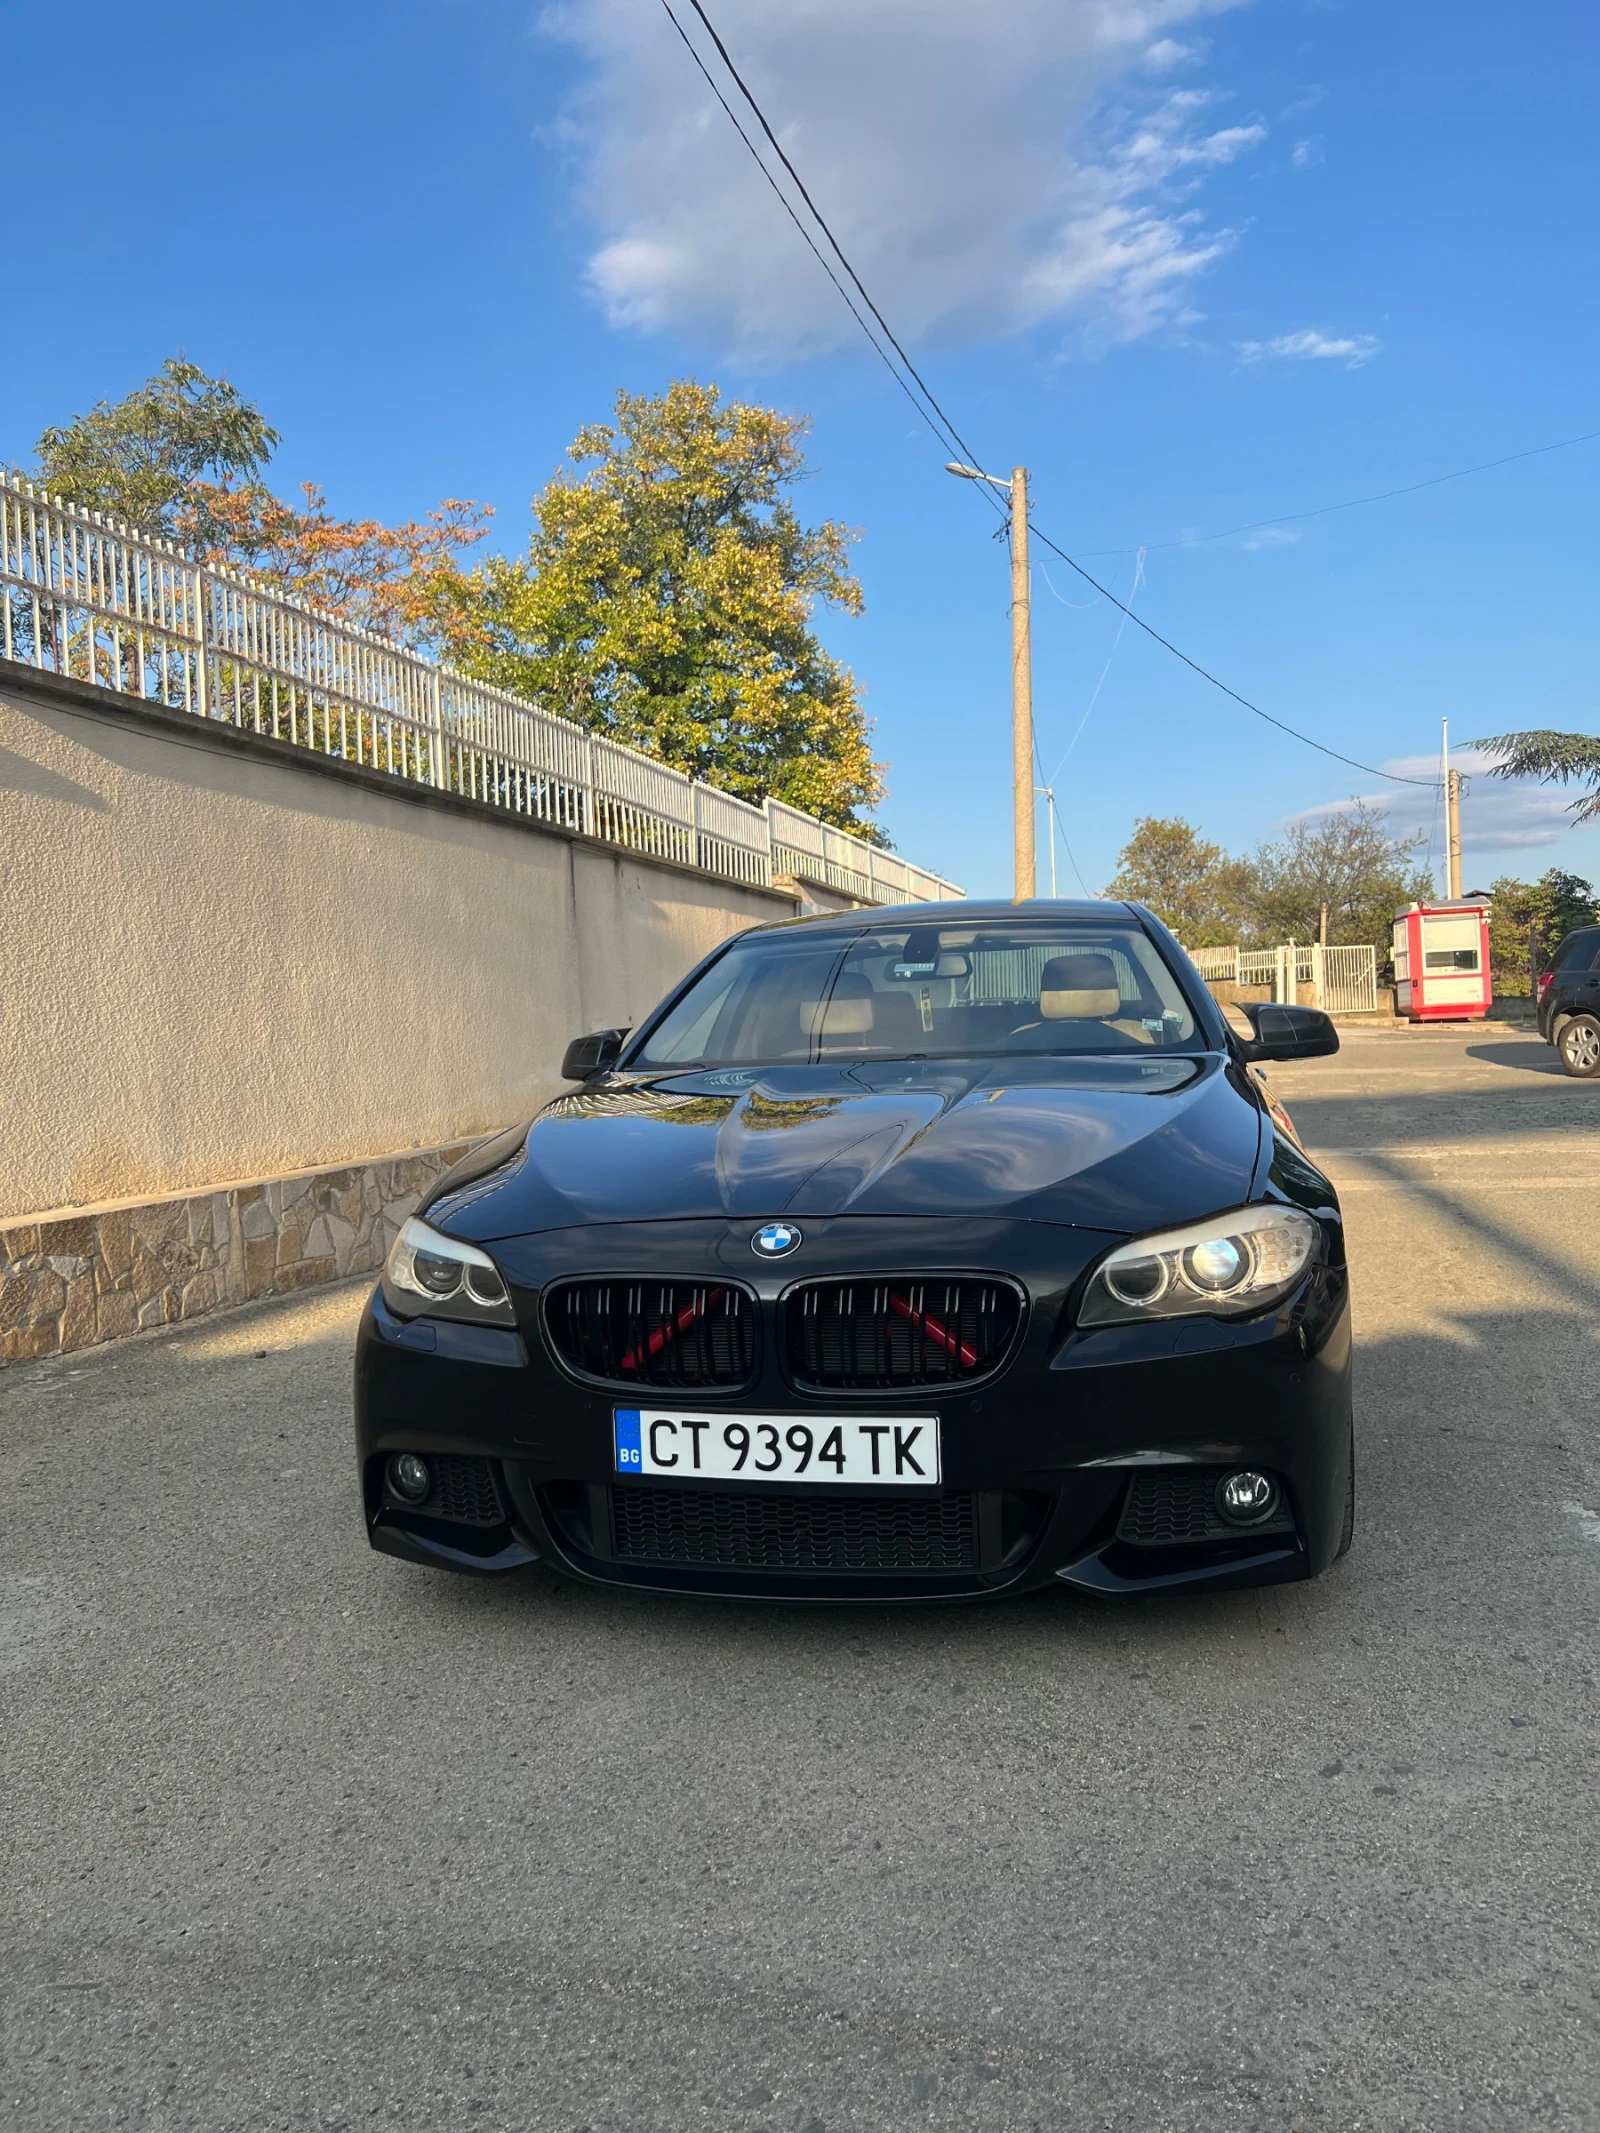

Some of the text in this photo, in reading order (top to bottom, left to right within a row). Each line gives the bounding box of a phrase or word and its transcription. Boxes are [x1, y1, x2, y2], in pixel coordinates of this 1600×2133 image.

[620, 1448, 640, 1463] BG
[649, 1419, 926, 1476] CT 9394 TK
